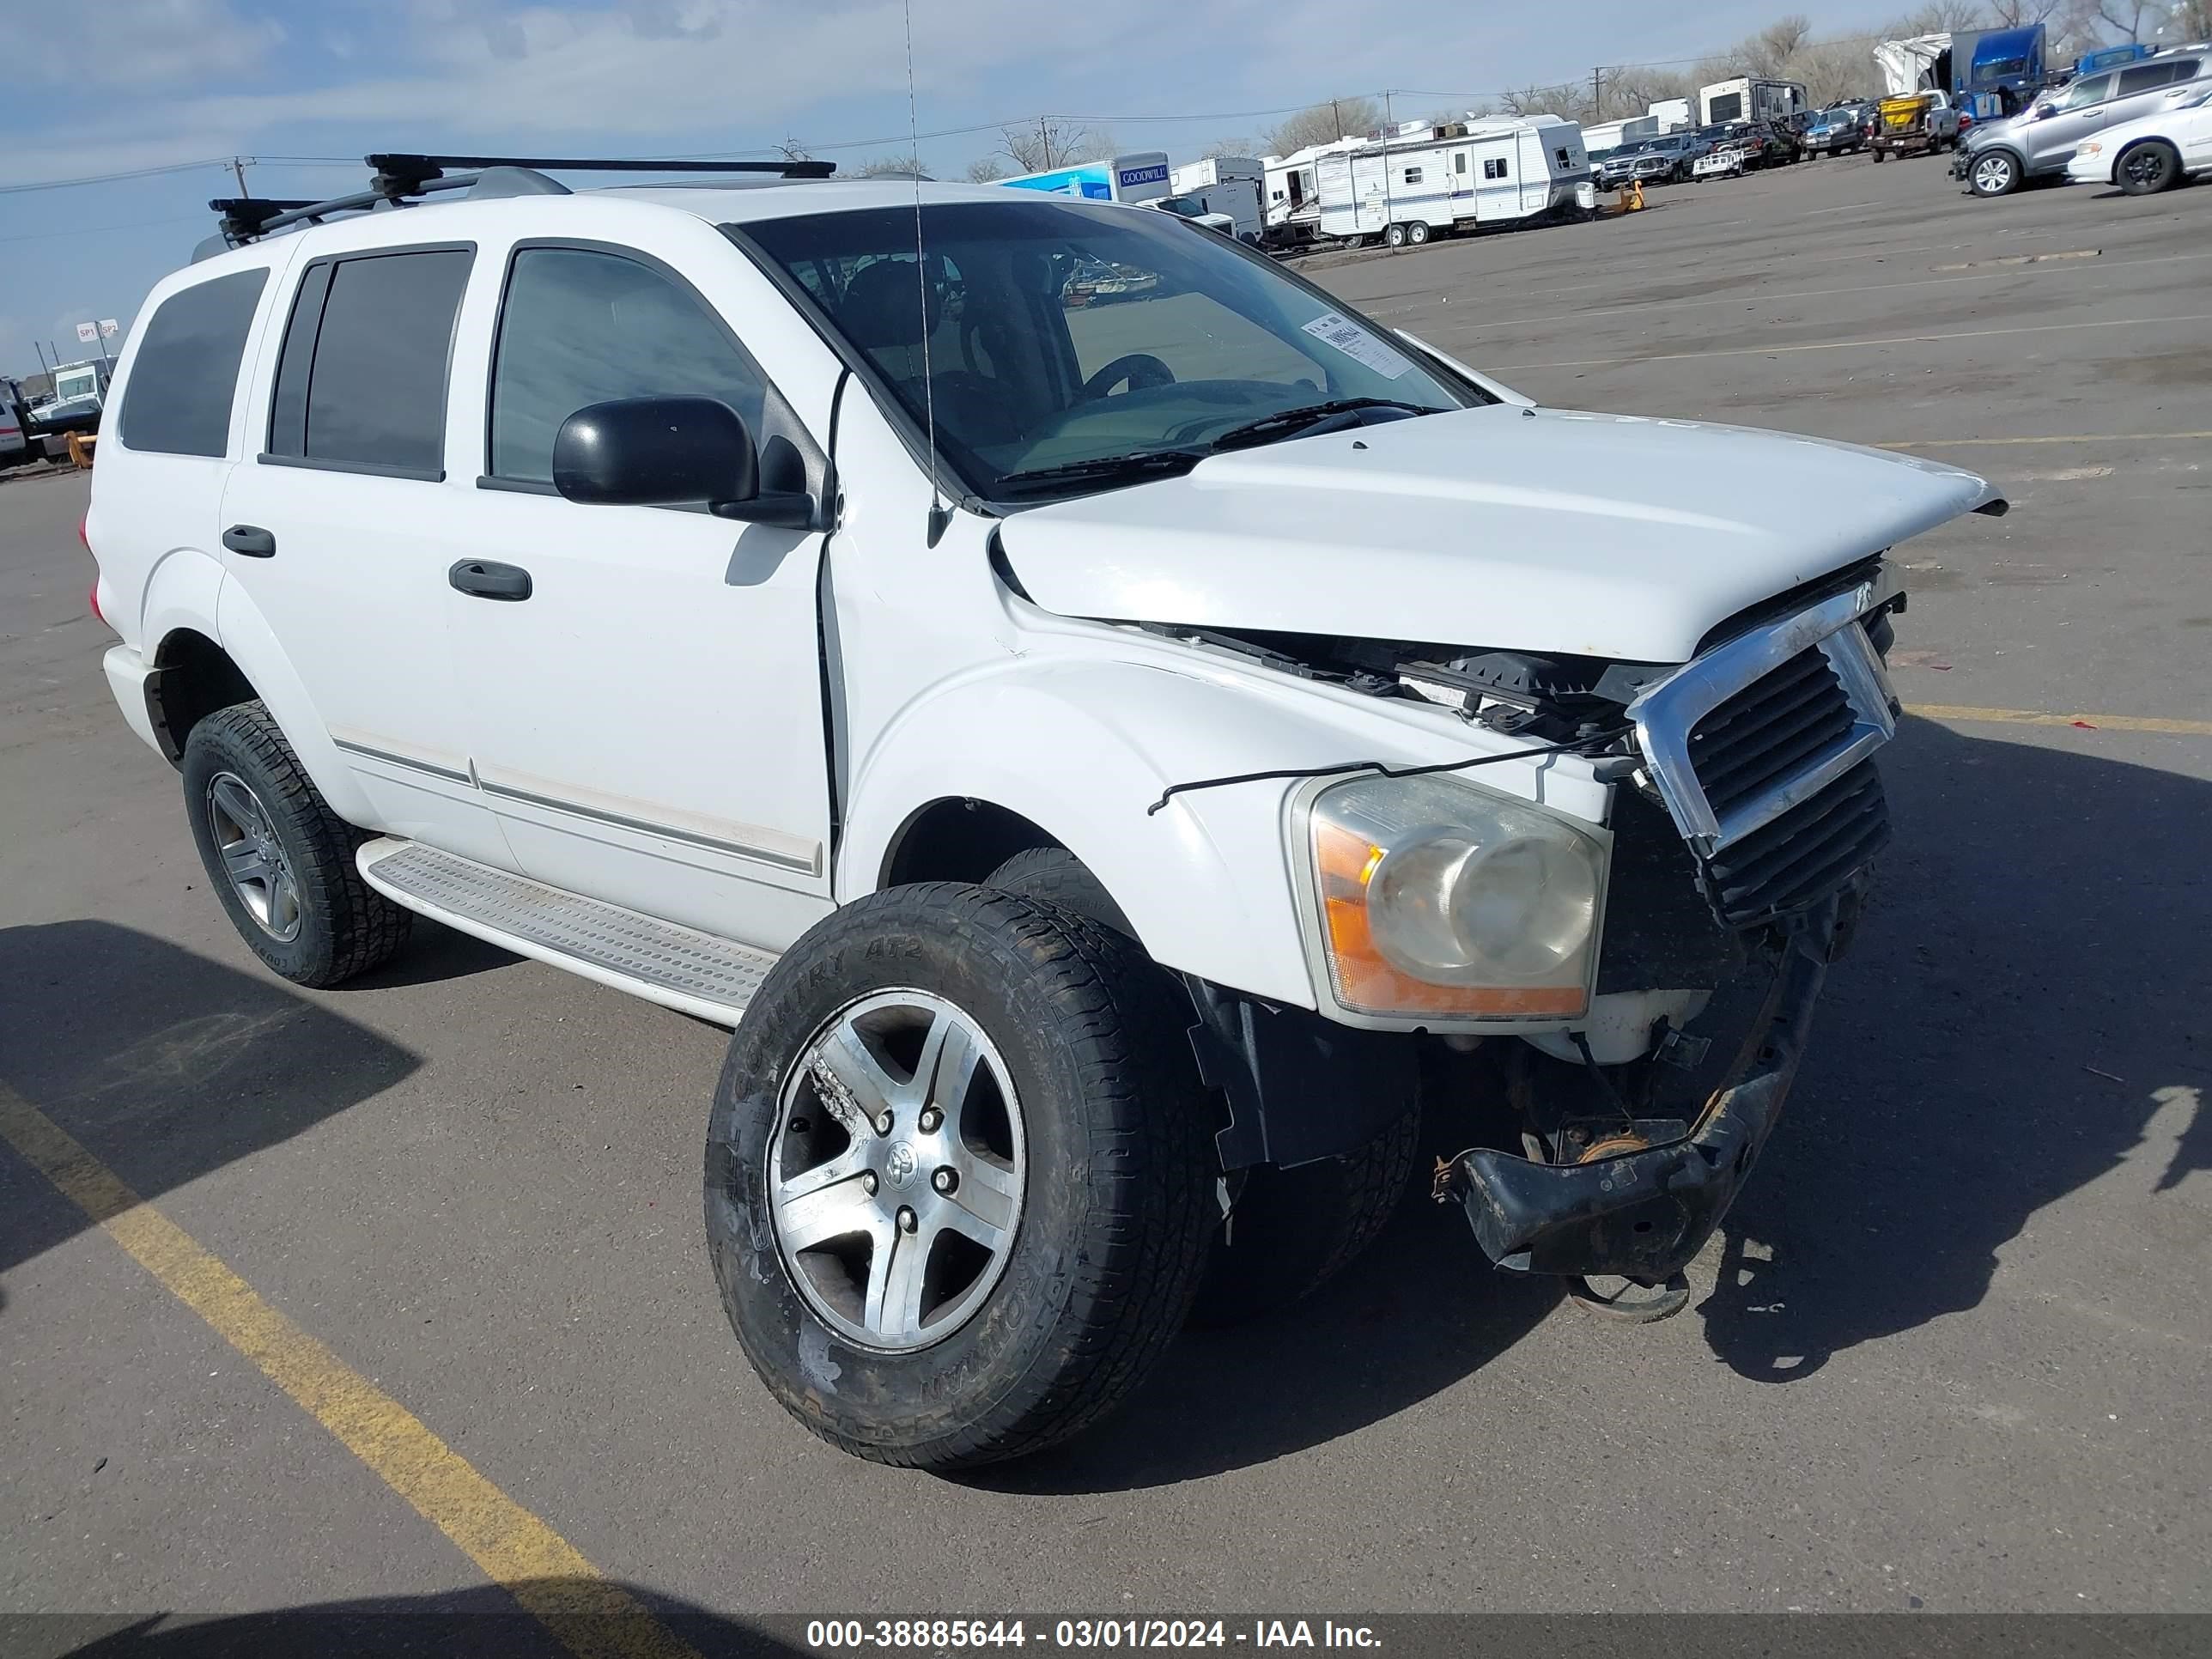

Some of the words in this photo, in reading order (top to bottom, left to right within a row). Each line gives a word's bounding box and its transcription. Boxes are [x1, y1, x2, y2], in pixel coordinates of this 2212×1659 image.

[1122, 168, 1165, 184] GOODWILL
[80, 328, 94, 337] SP1
[102, 325, 117, 334] SP2
[733, 947, 846, 1103] COUNTRY
[864, 935, 924, 962] AT2
